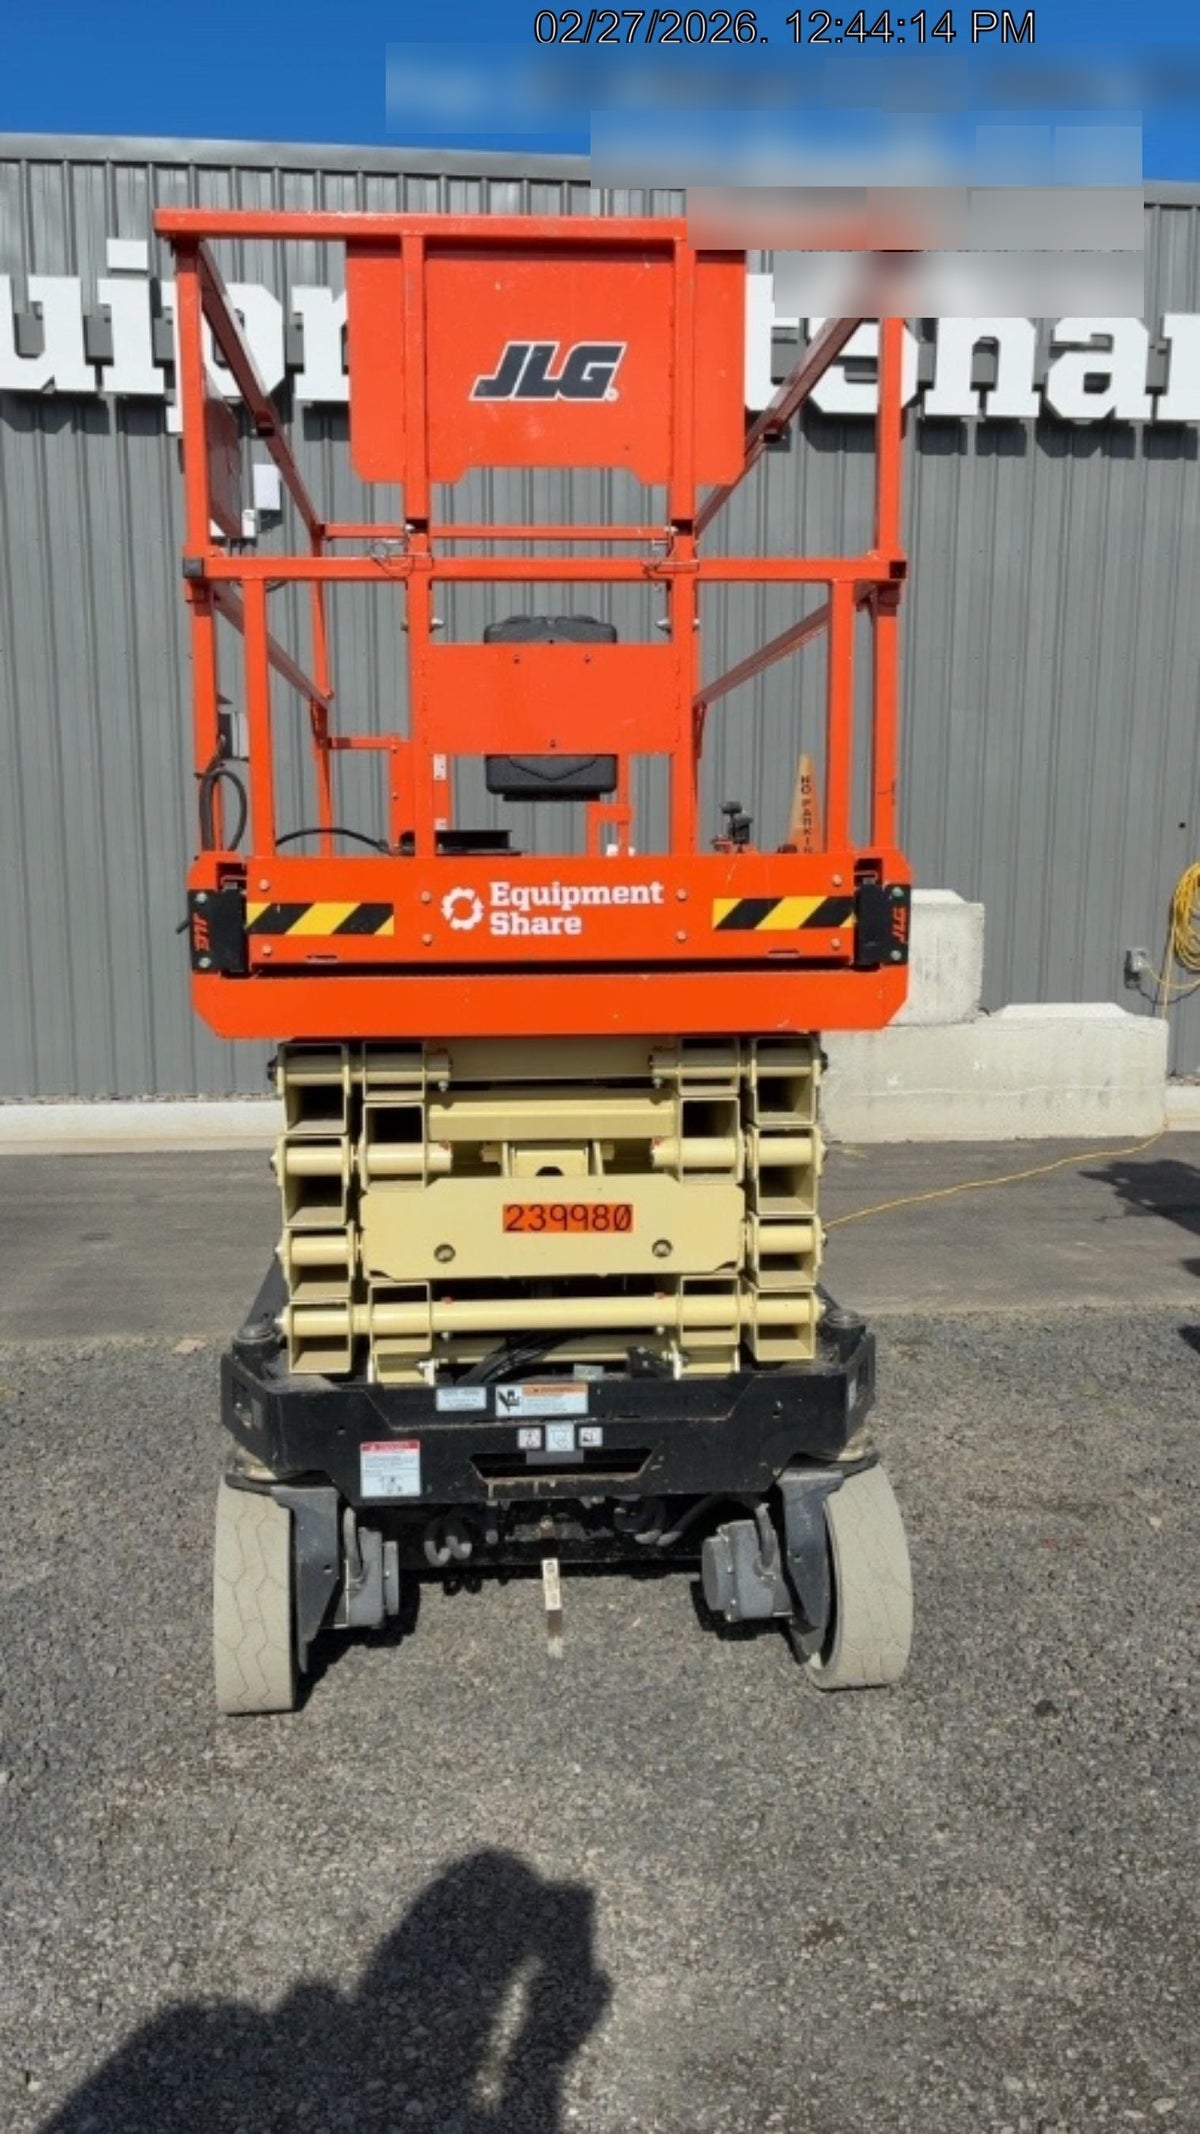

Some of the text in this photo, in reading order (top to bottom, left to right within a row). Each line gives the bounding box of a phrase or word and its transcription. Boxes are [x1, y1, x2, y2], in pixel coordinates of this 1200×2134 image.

[469, 341, 627, 402] JLG
[801, 775, 812, 795] NO
[489, 881, 664, 911] Equipment
[489, 911, 582, 935] Share
[505, 1204, 632, 1231] 239980
